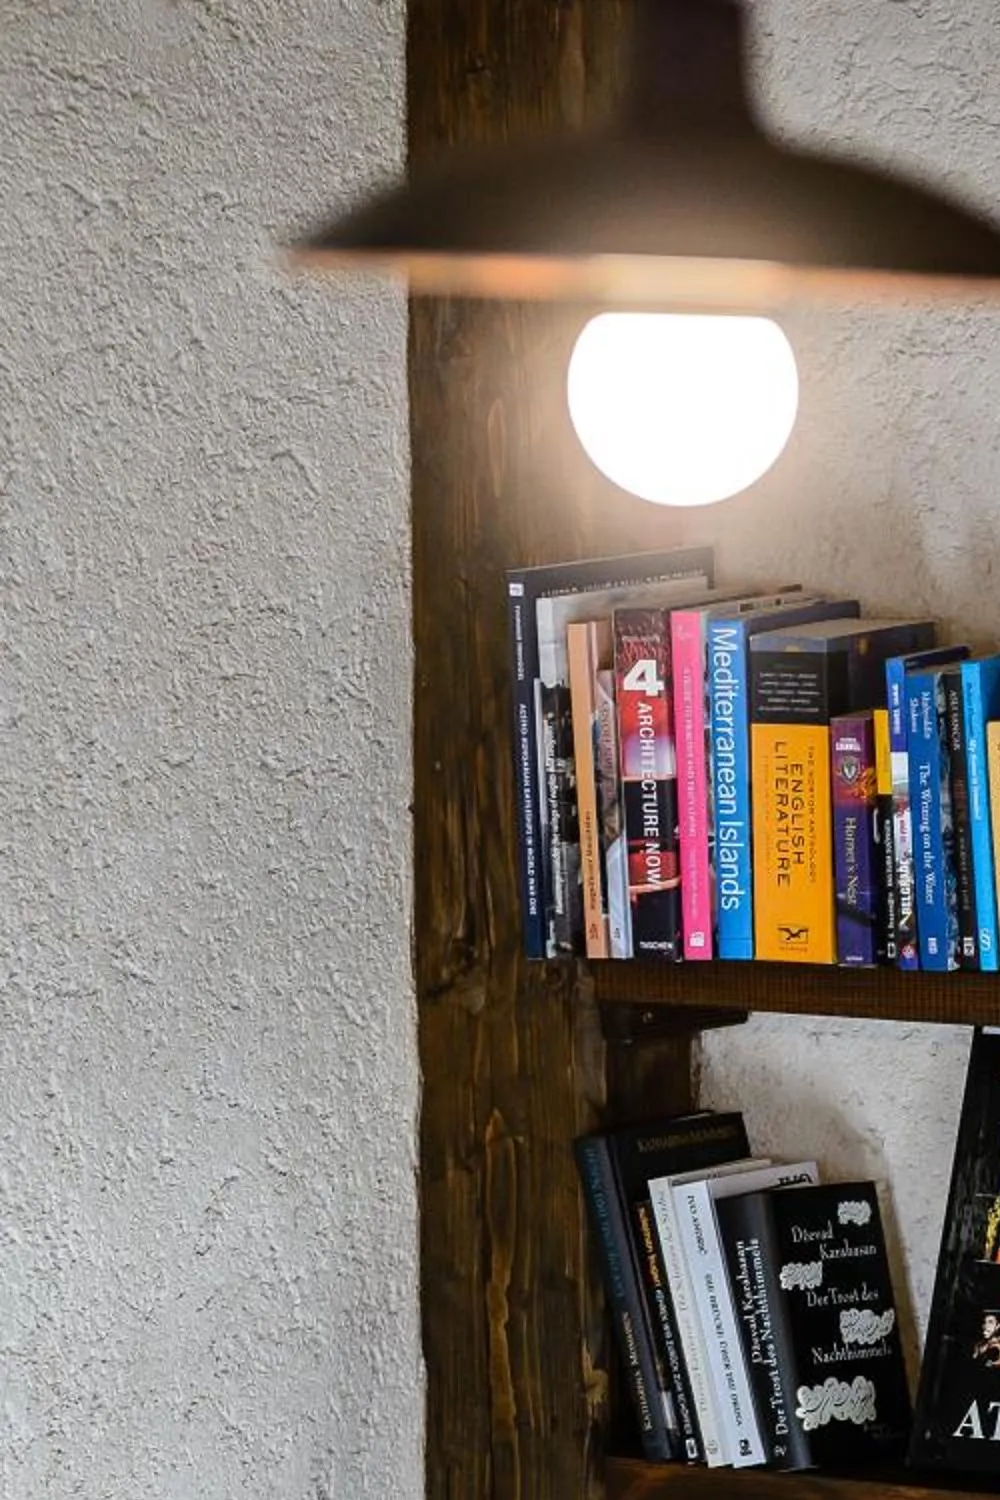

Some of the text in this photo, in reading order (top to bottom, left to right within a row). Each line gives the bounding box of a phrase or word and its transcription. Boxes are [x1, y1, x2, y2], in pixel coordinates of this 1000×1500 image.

[621, 658, 665, 696] 4
[635, 700, 659, 836] ARCHITECTURE
[709, 626, 745, 909] Mediterranean Islands
[917, 760, 929, 784] The
[774, 741, 789, 886] LITERATURE
[790, 763, 804, 864] ENGLISH
[921, 832, 931, 848] on
[923, 850, 934, 869] the
[924, 870, 936, 903] Water
[686, 1193, 698, 1214] IVO
[744, 1237, 775, 1342] Nachthimmels
[765, 1370, 785, 1409] Trost
[772, 1409, 789, 1437] Der
